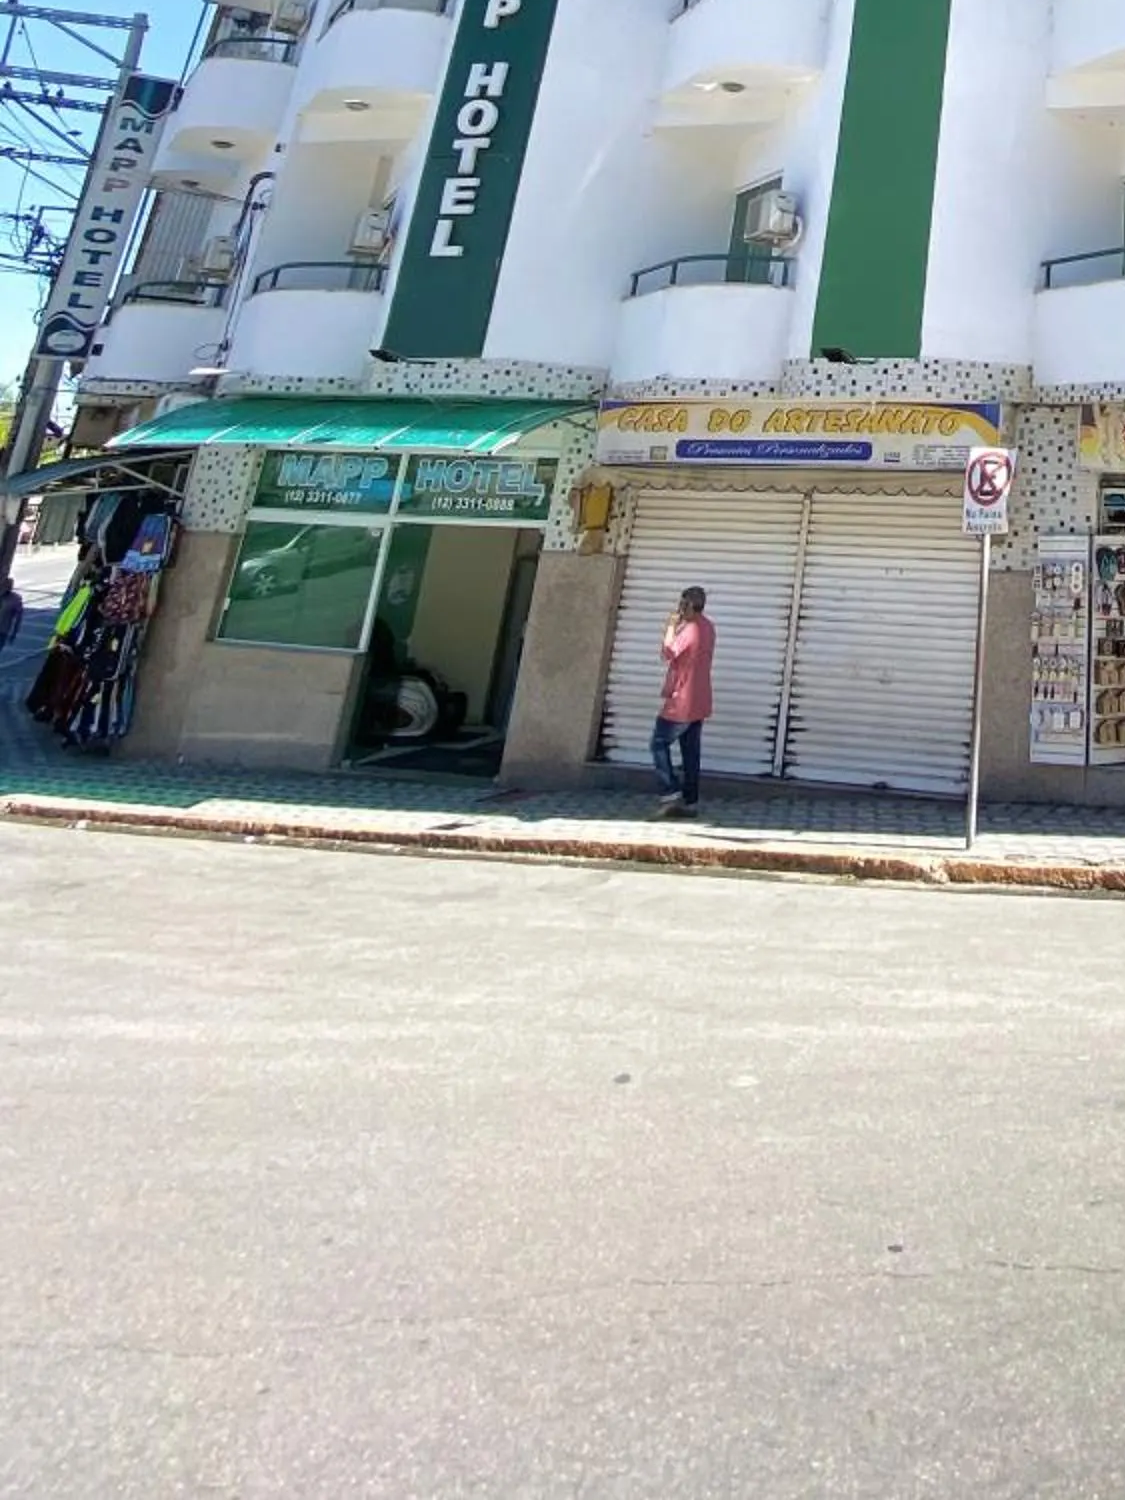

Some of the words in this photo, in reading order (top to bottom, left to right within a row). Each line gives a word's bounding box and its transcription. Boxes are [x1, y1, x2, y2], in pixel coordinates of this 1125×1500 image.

[103, 116, 155, 193] MAPP
[429, 61, 509, 258] HOTEL
[67, 205, 125, 309] HOTEL
[617, 407, 689, 433] CASA
[706, 407, 754, 434] DO
[761, 407, 962, 437] ARTESANATO
[277, 453, 389, 489] MAPP
[414, 459, 545, 495] HOTEL
